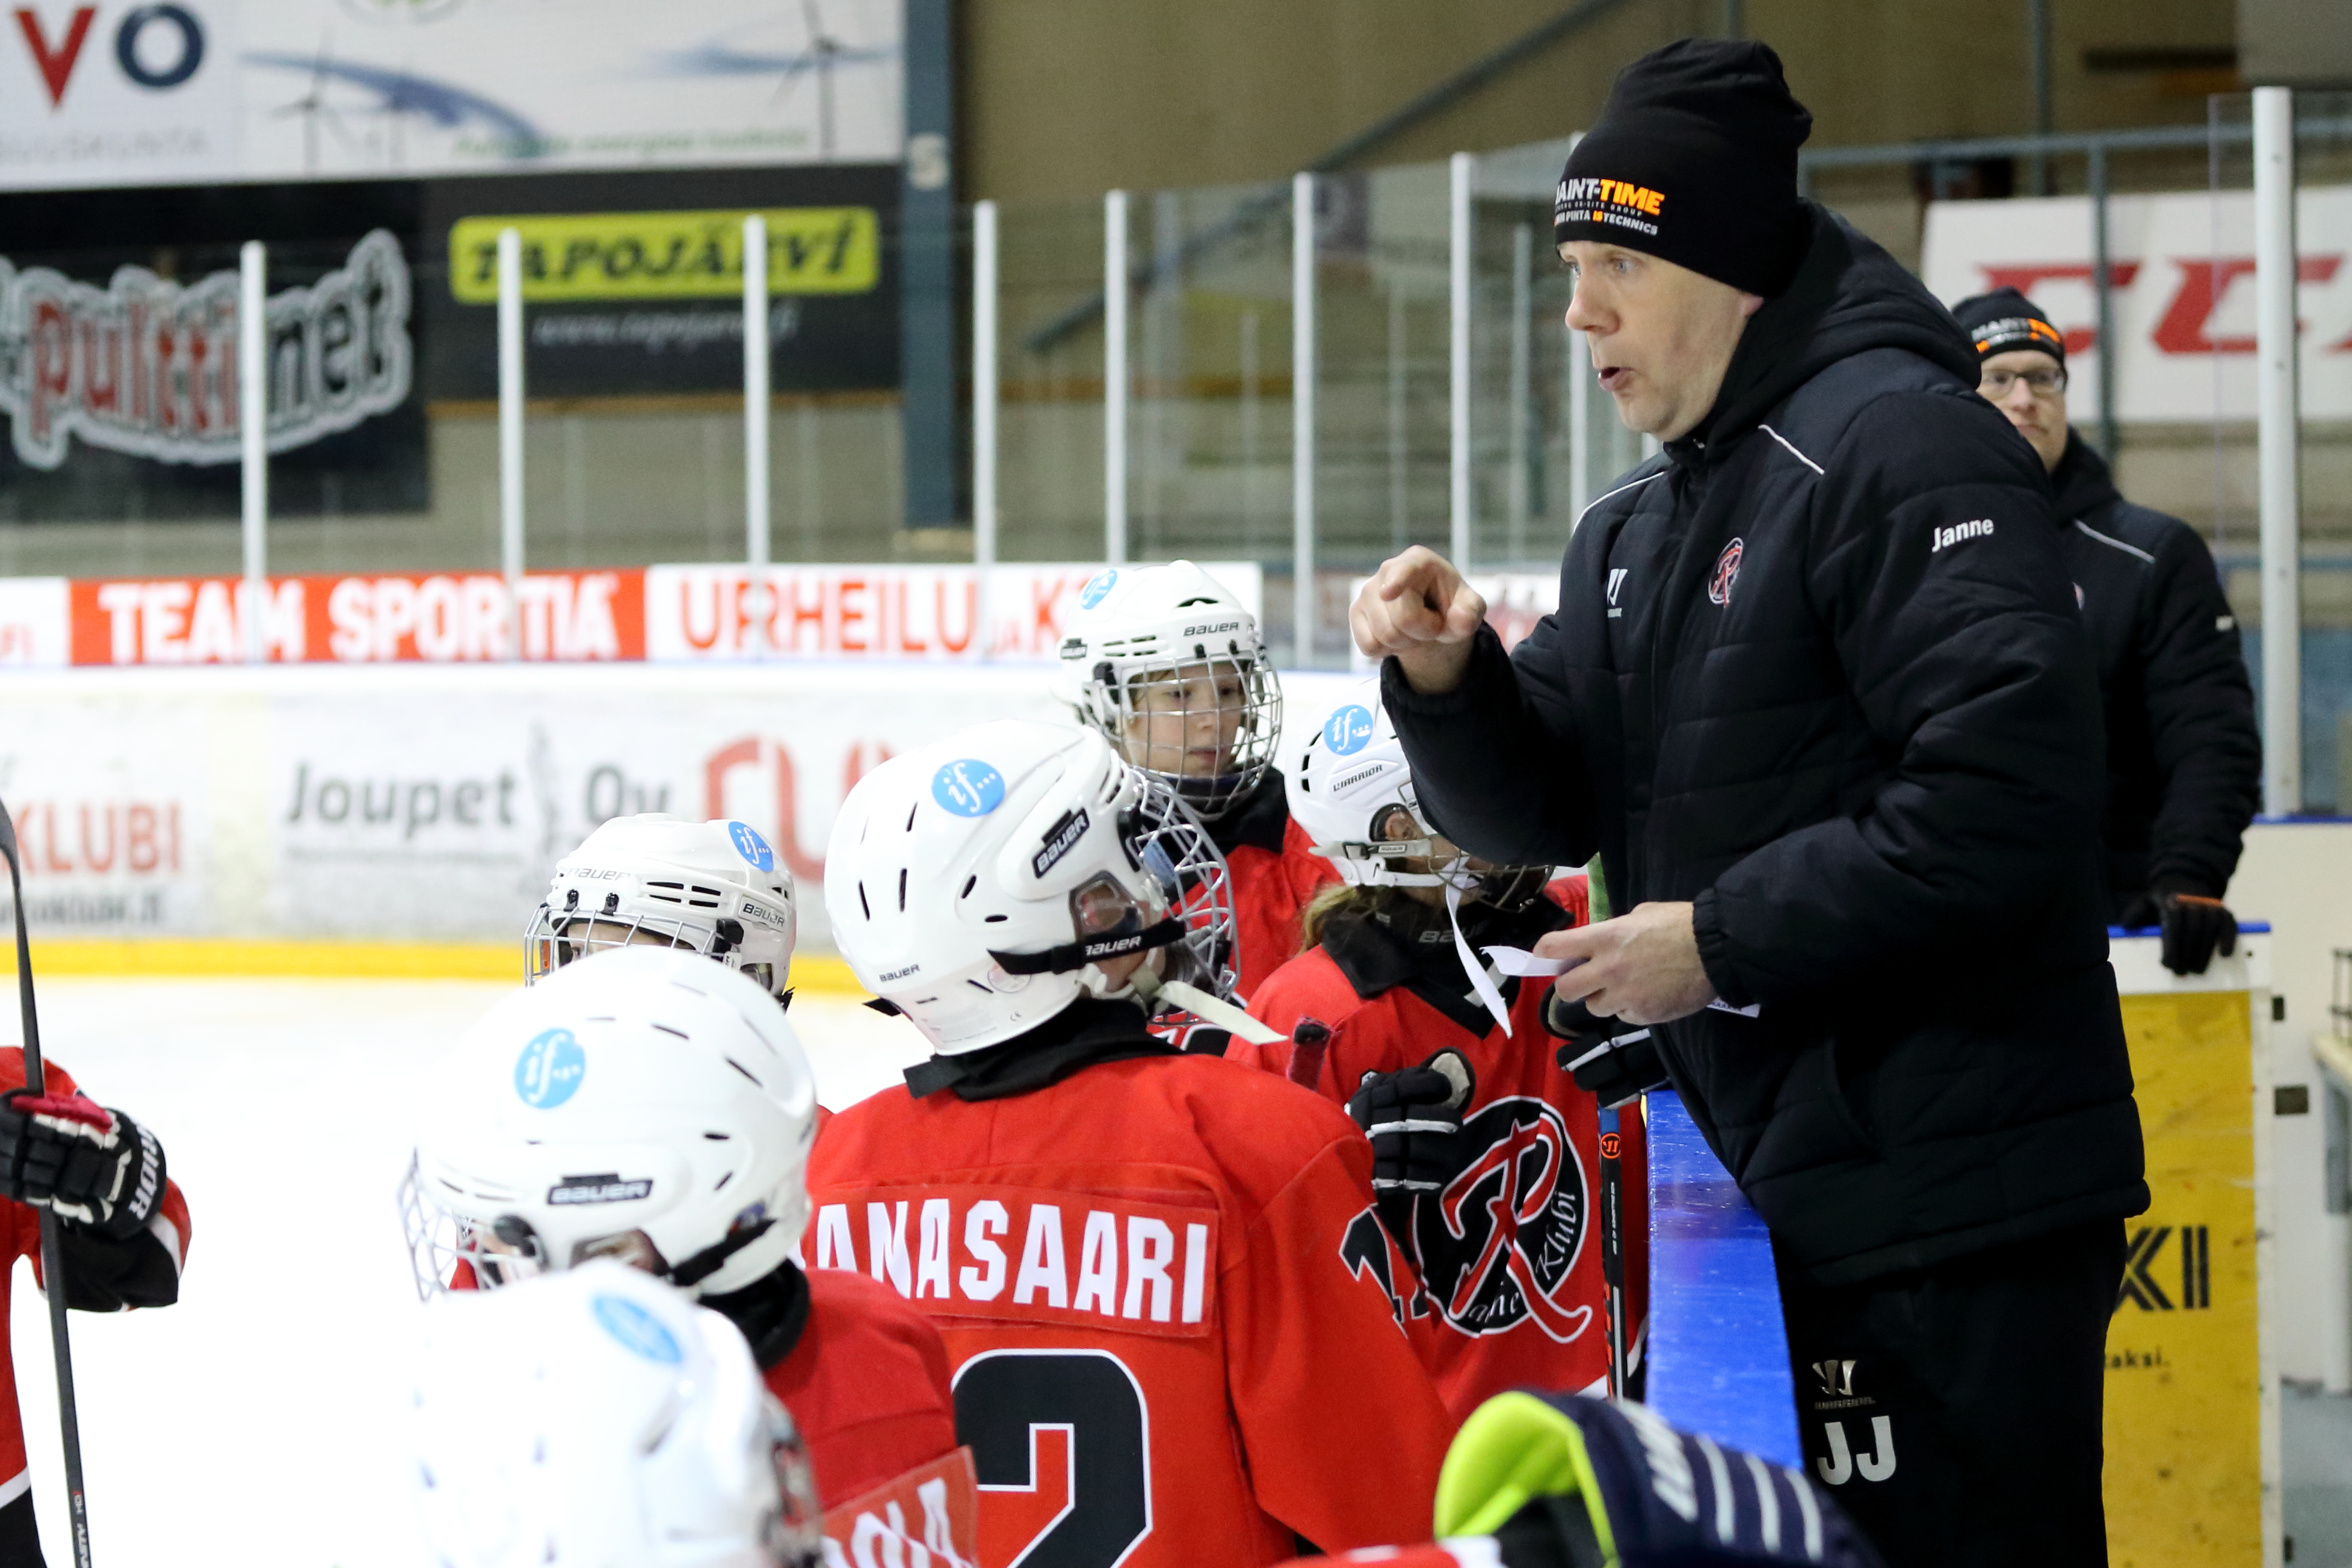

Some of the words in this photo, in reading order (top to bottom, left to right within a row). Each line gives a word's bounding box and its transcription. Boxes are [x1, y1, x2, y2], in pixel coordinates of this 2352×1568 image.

[1931, 518, 1995, 553] Janne
[99, 579, 305, 662] TEAM
[329, 573, 620, 661] SPORTIA
[679, 579, 978, 653] URHEILU
[1182, 622, 1239, 637] BAUER
[285, 759, 517, 840] Joupet
[1332, 764, 1383, 792] WARRIOR
[1036, 813, 1088, 873] BAUER
[742, 903, 785, 928] BAUER
[878, 963, 921, 983] BAUER
[1816, 1415, 1897, 1486] JJ
